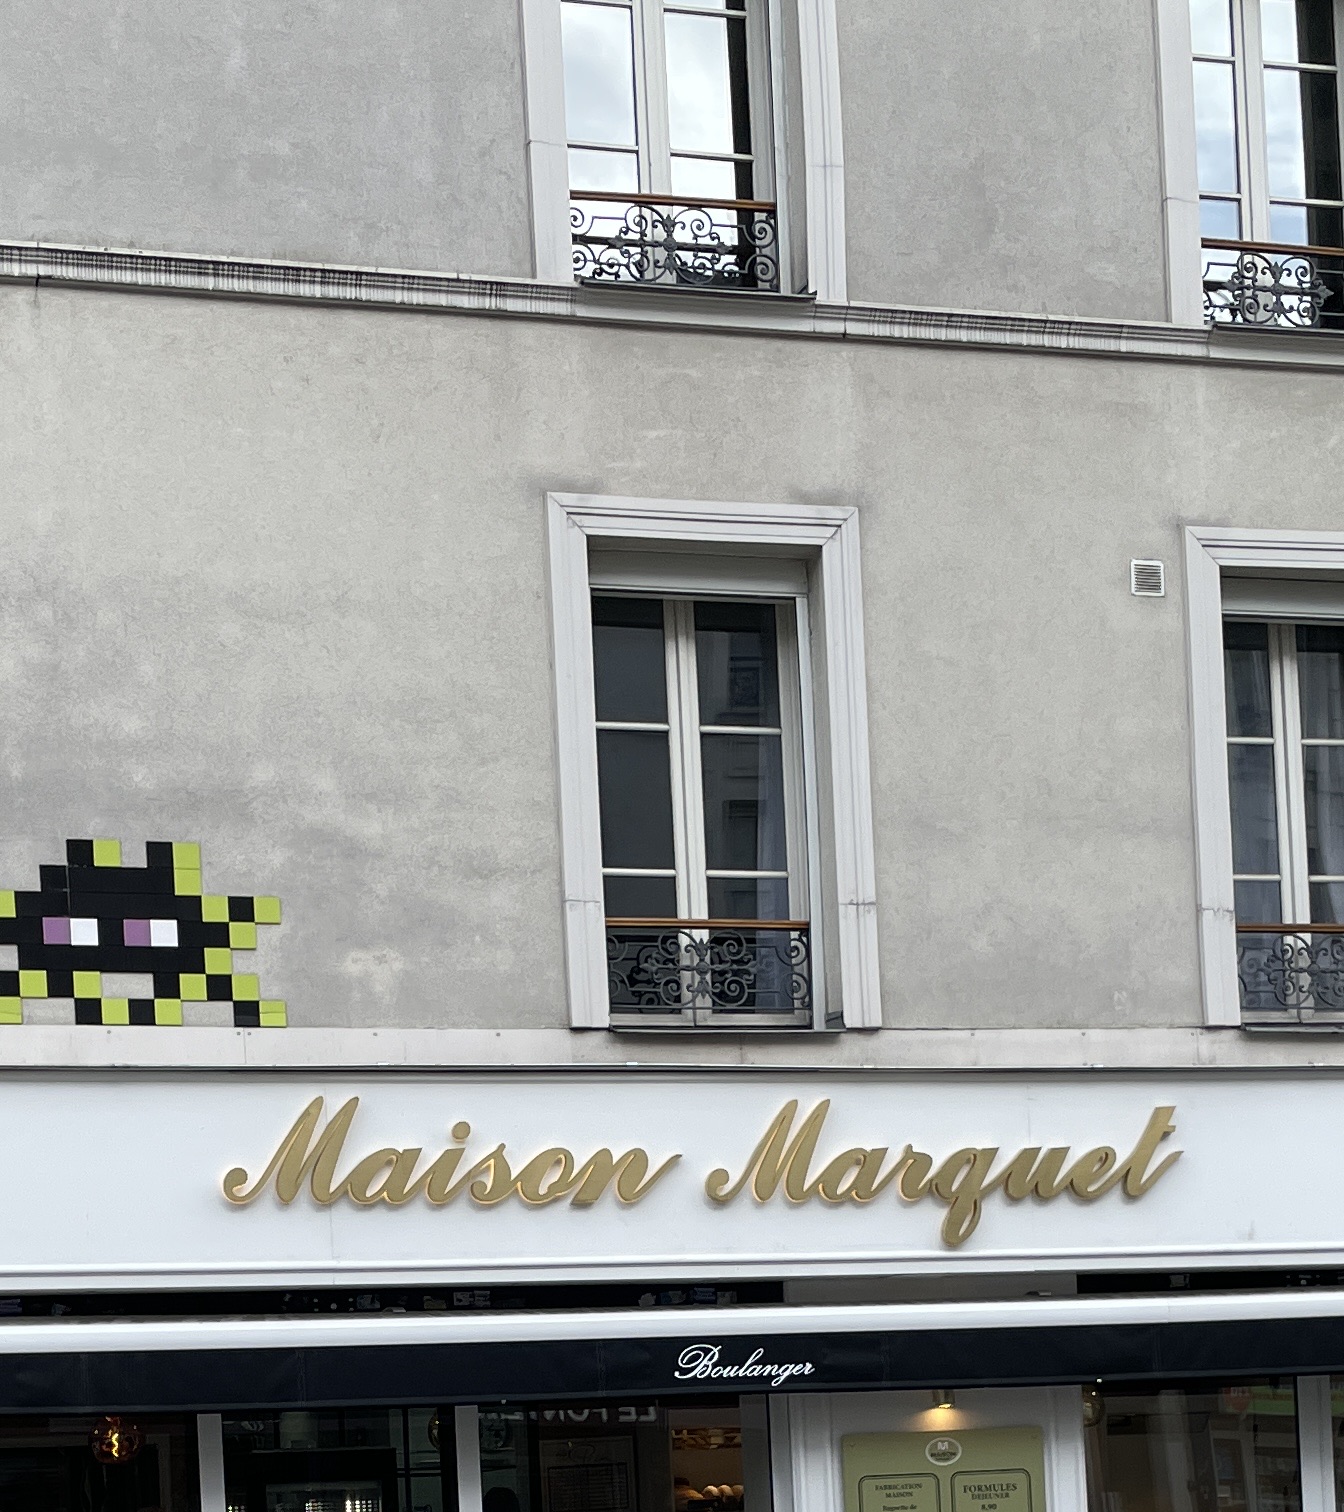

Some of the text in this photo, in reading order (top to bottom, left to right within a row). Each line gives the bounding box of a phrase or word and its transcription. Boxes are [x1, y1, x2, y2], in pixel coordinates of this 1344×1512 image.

[222, 1095, 1185, 1249] Maison Marquet
[674, 1343, 815, 1387] Boulanger
[963, 1482, 1019, 1494] FORMULES
